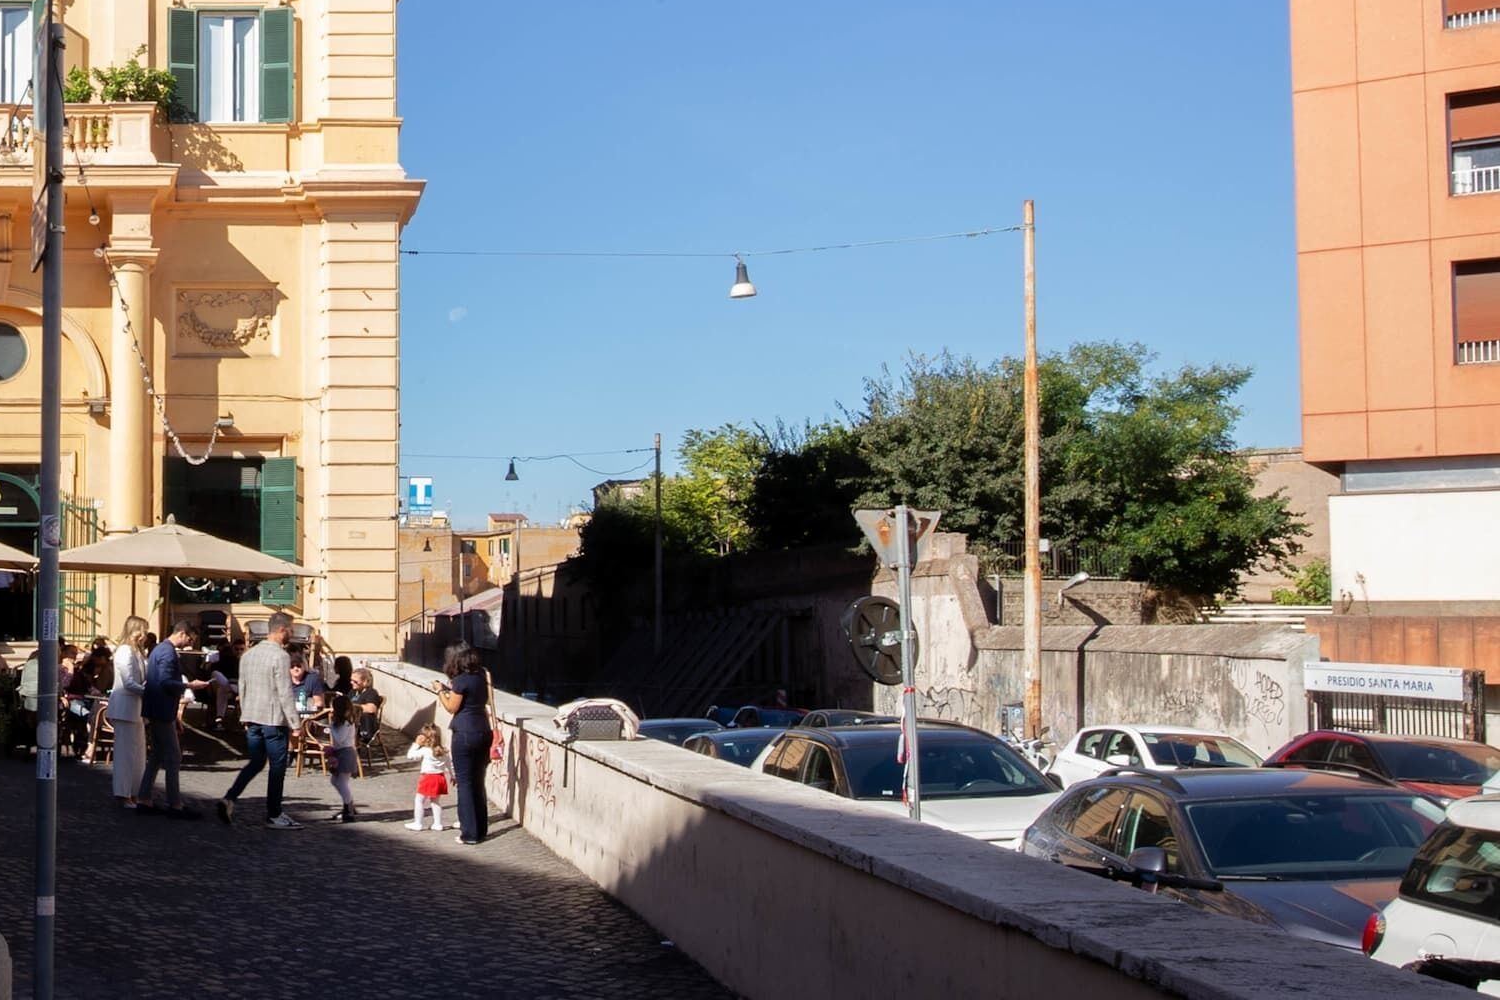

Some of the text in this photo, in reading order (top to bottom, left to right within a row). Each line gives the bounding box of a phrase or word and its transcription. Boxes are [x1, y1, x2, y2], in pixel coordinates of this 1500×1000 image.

[1327, 675, 1434, 693] PRESIDIO SANTA MARIA
